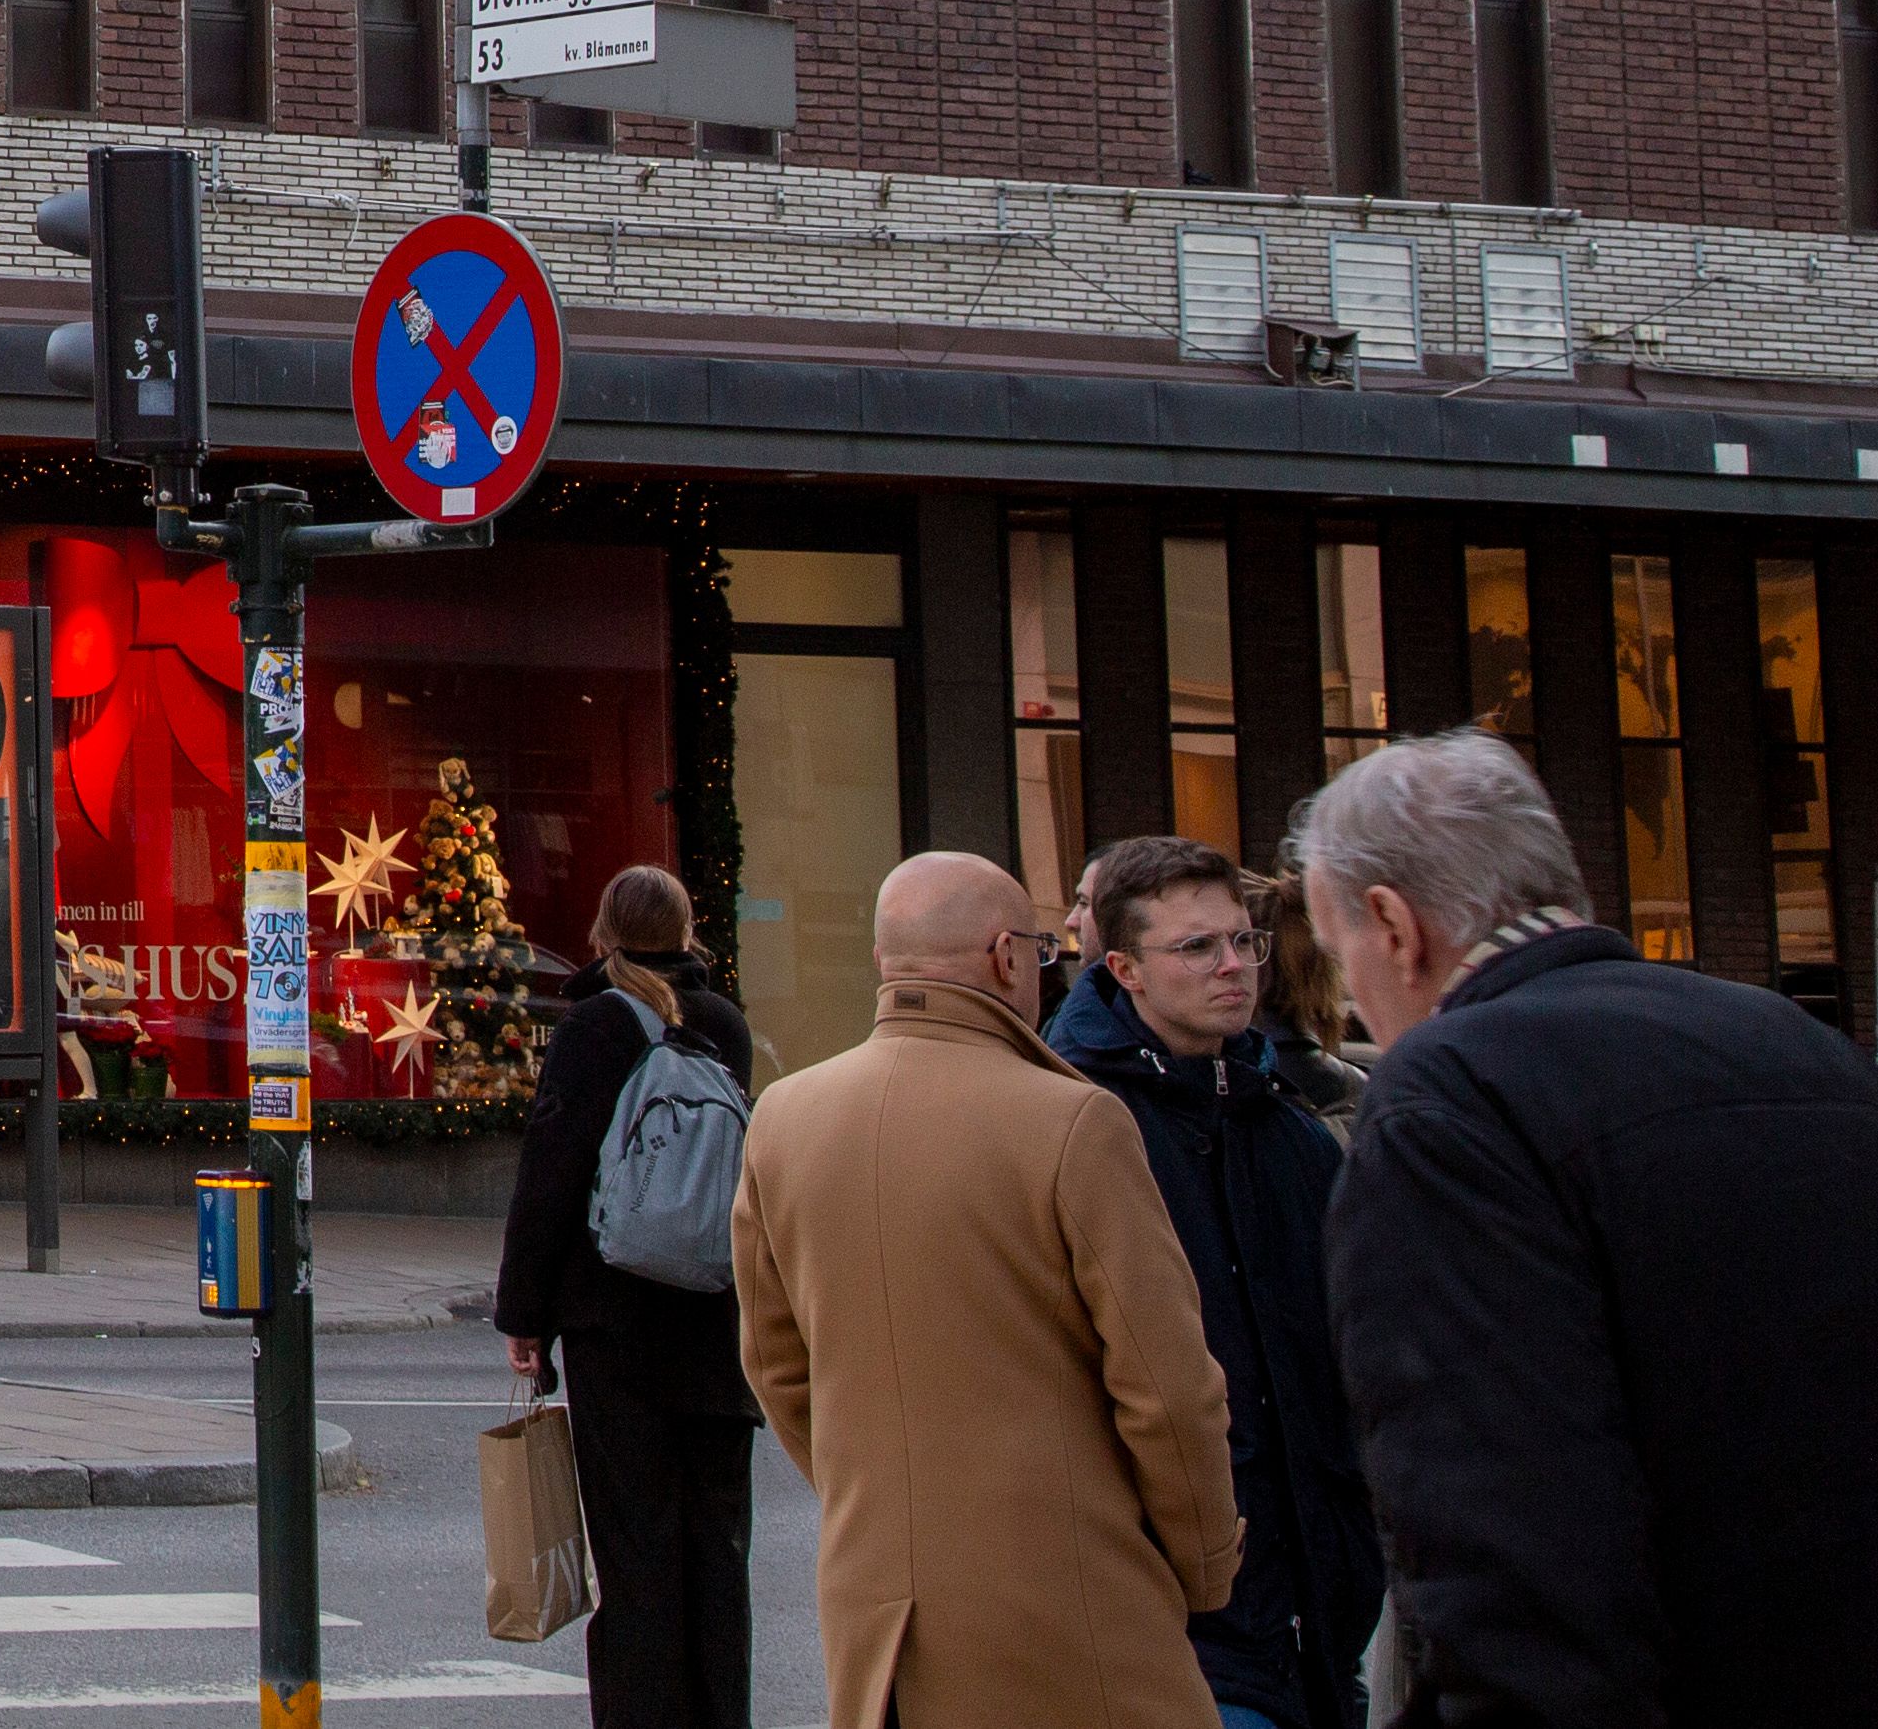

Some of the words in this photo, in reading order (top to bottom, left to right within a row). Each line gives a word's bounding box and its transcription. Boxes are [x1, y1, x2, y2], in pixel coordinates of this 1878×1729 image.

[477, 38, 504, 73] 53
[565, 44, 581, 61] kv.
[586, 40, 648, 59] Blåmannen
[100, 901, 118, 921] in
[121, 900, 144, 921] till
[250, 912, 306, 935] VINY
[250, 934, 306, 967] SAL
[630, 1152, 659, 1214] Norconsult
